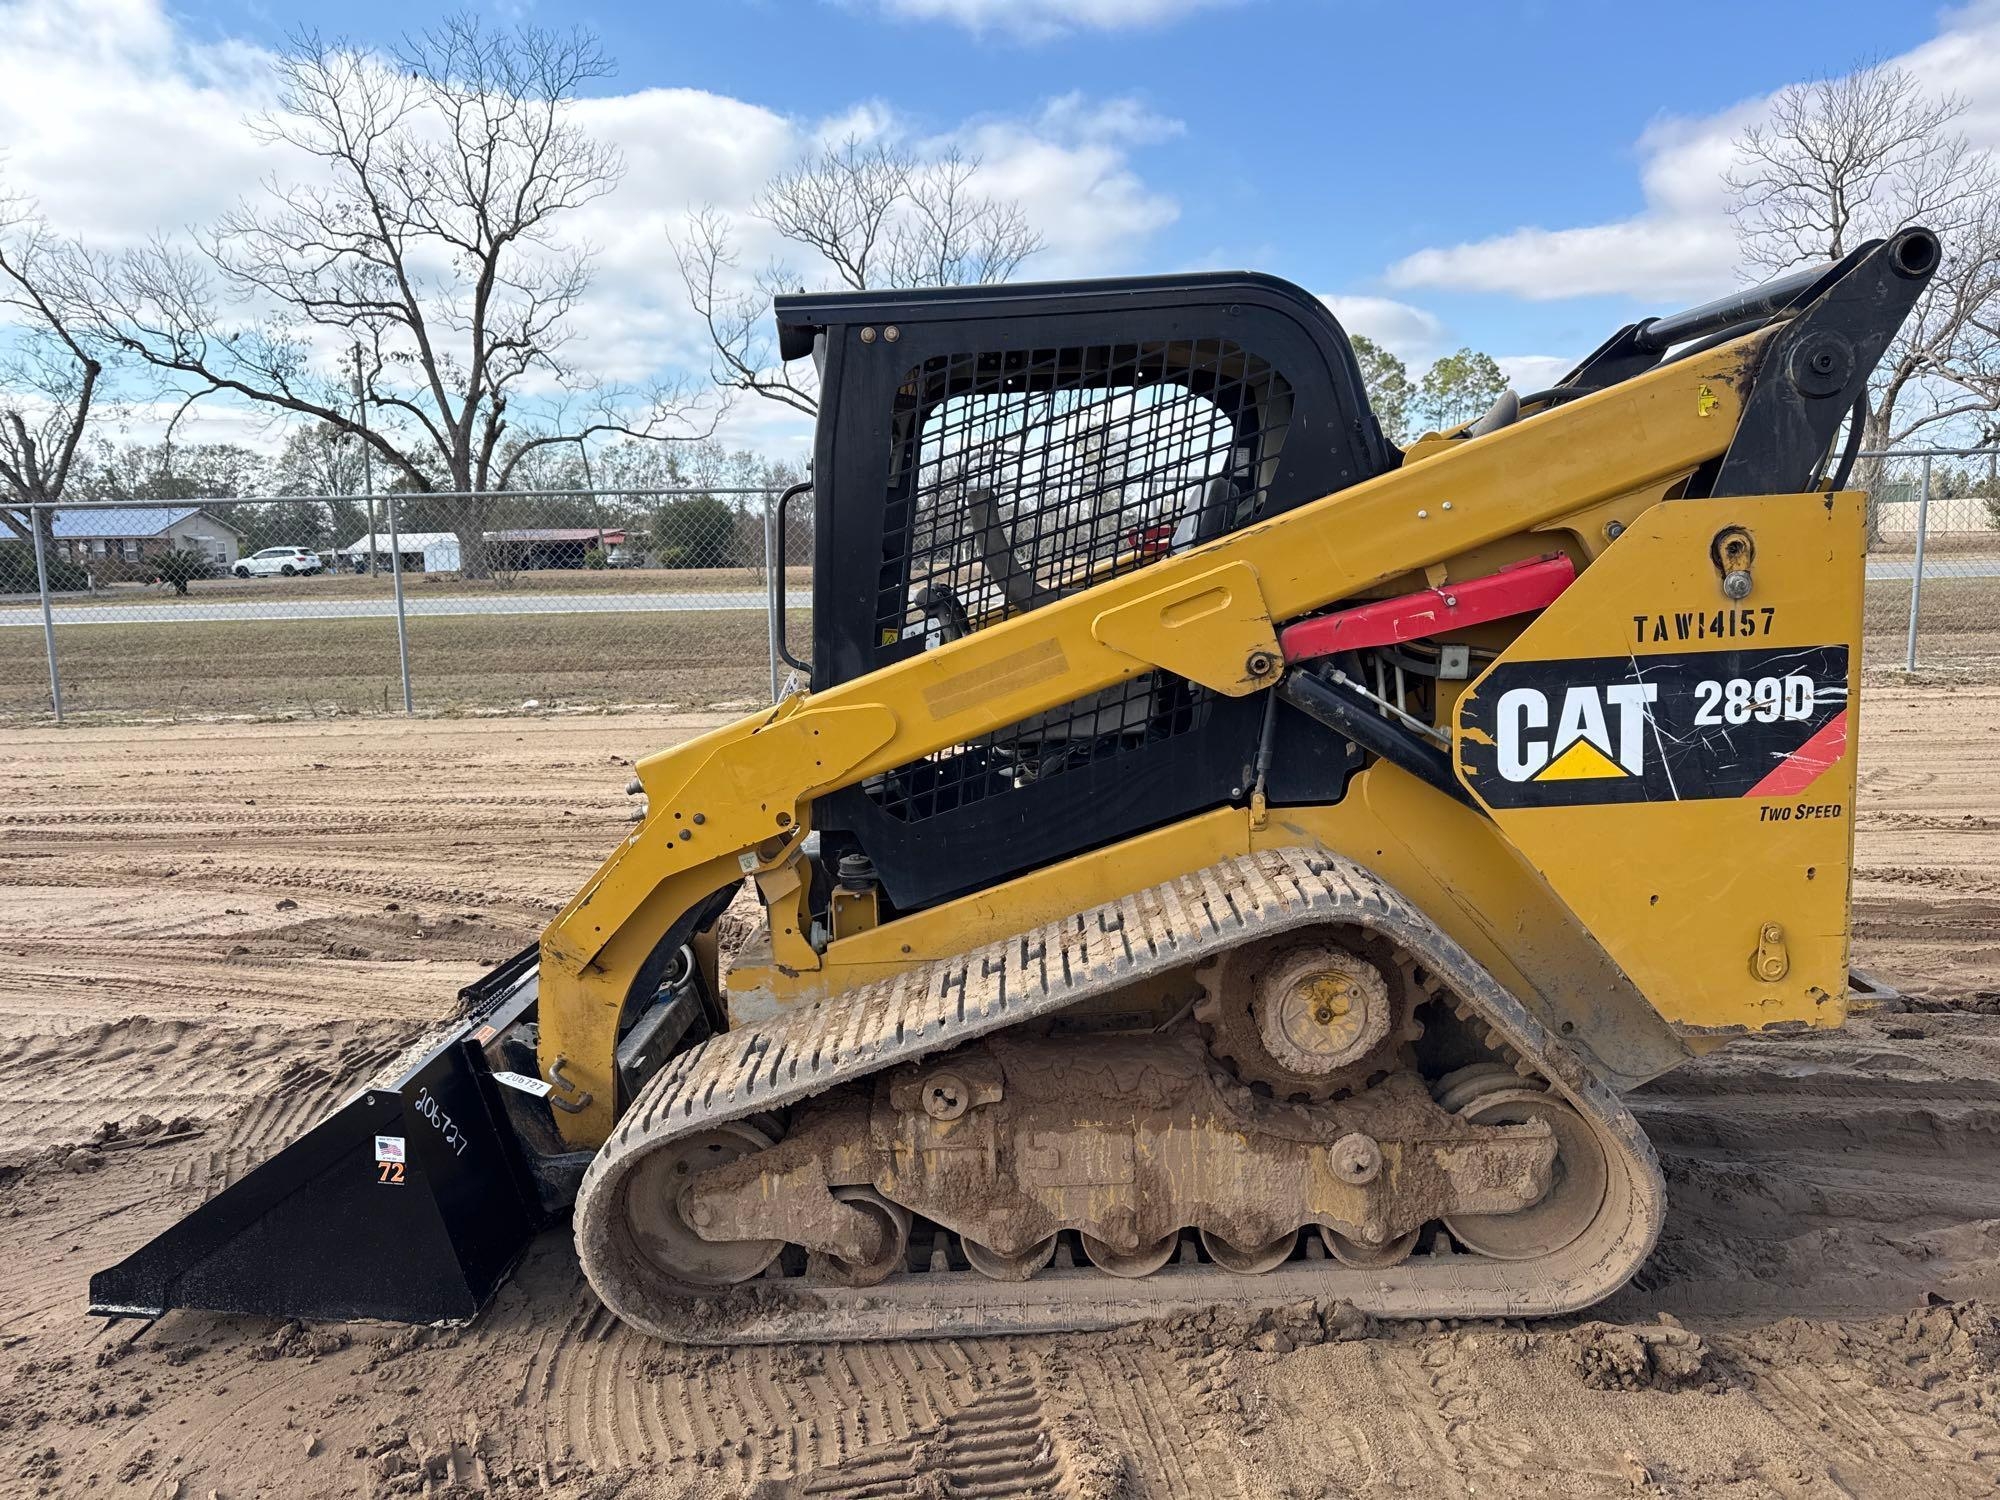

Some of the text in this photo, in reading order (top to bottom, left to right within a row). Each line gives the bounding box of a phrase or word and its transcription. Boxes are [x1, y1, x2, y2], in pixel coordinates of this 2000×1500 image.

[1633, 607, 1775, 643] TAW14157
[1496, 675, 1815, 782] CAT 289D
[1760, 804, 1842, 821] TWO SPEED
[505, 1072, 545, 1091] 206727
[414, 1086, 468, 1157] 206727
[378, 1161, 405, 1183] 72
